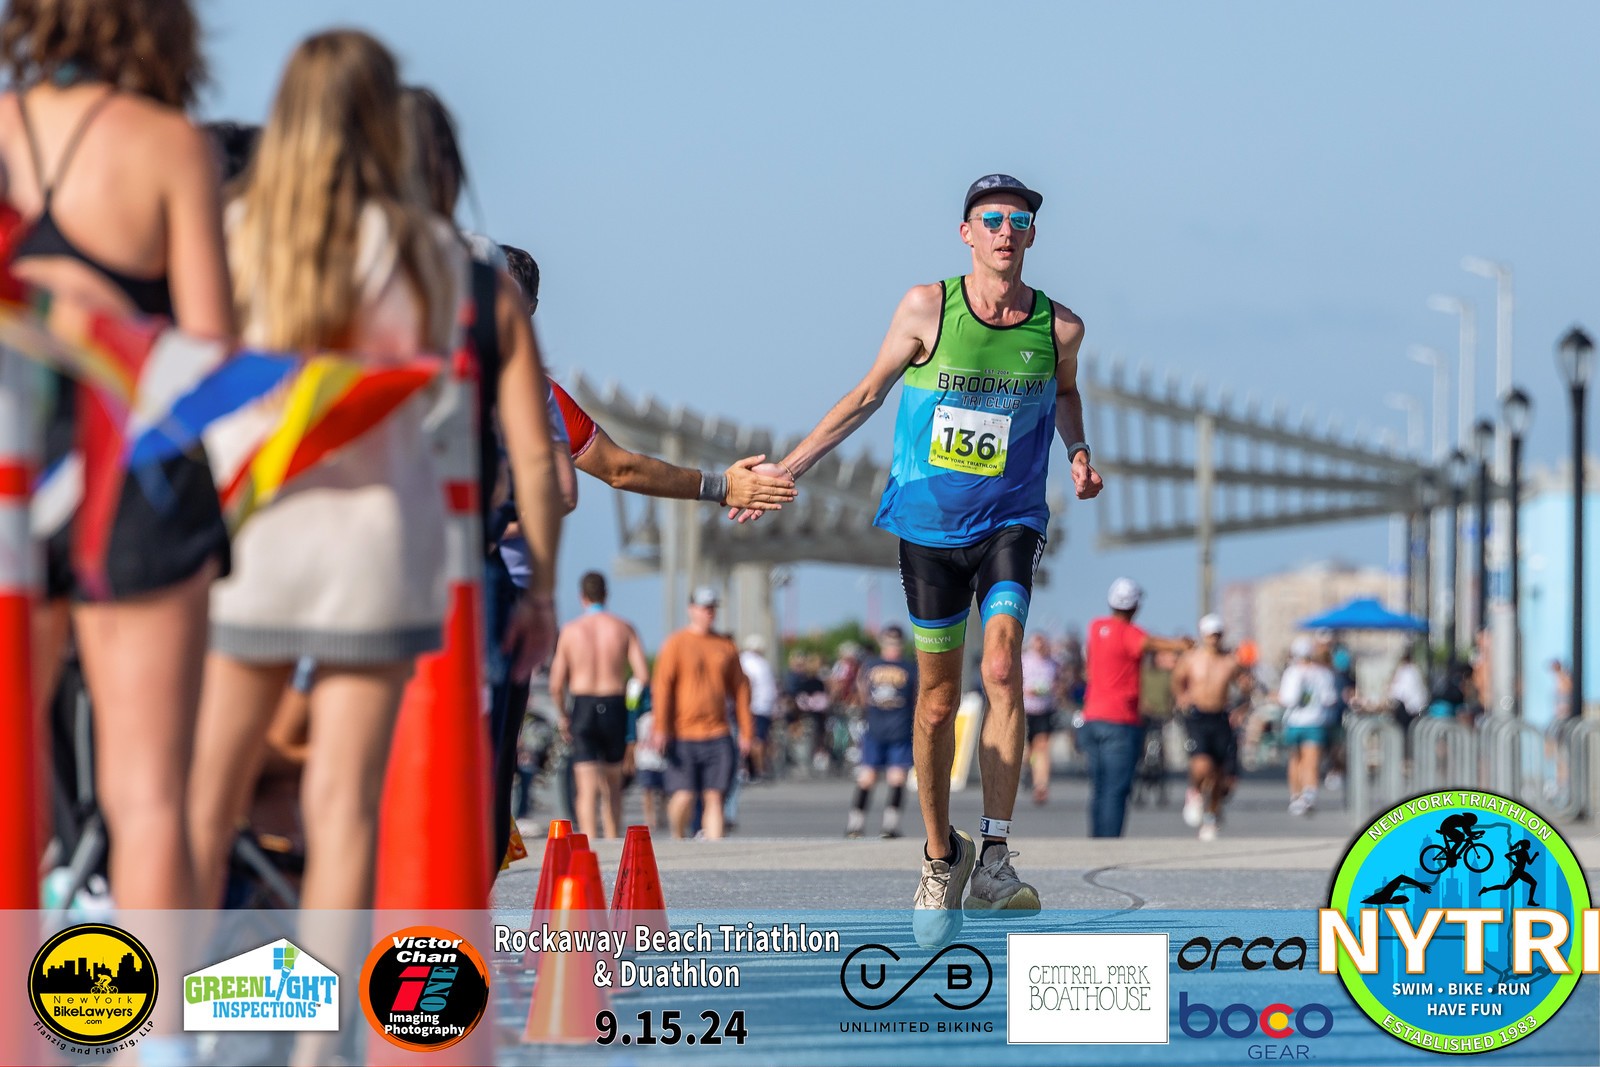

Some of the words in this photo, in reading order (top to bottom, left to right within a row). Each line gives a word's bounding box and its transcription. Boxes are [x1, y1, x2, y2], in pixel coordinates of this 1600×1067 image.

[938, 372, 1048, 397] BROOKLYN
[962, 395, 982, 408] TRI
[985, 397, 1022, 410] CLUB
[943, 427, 996, 461] 136
[967, 461, 997, 469] TRIATHLON
